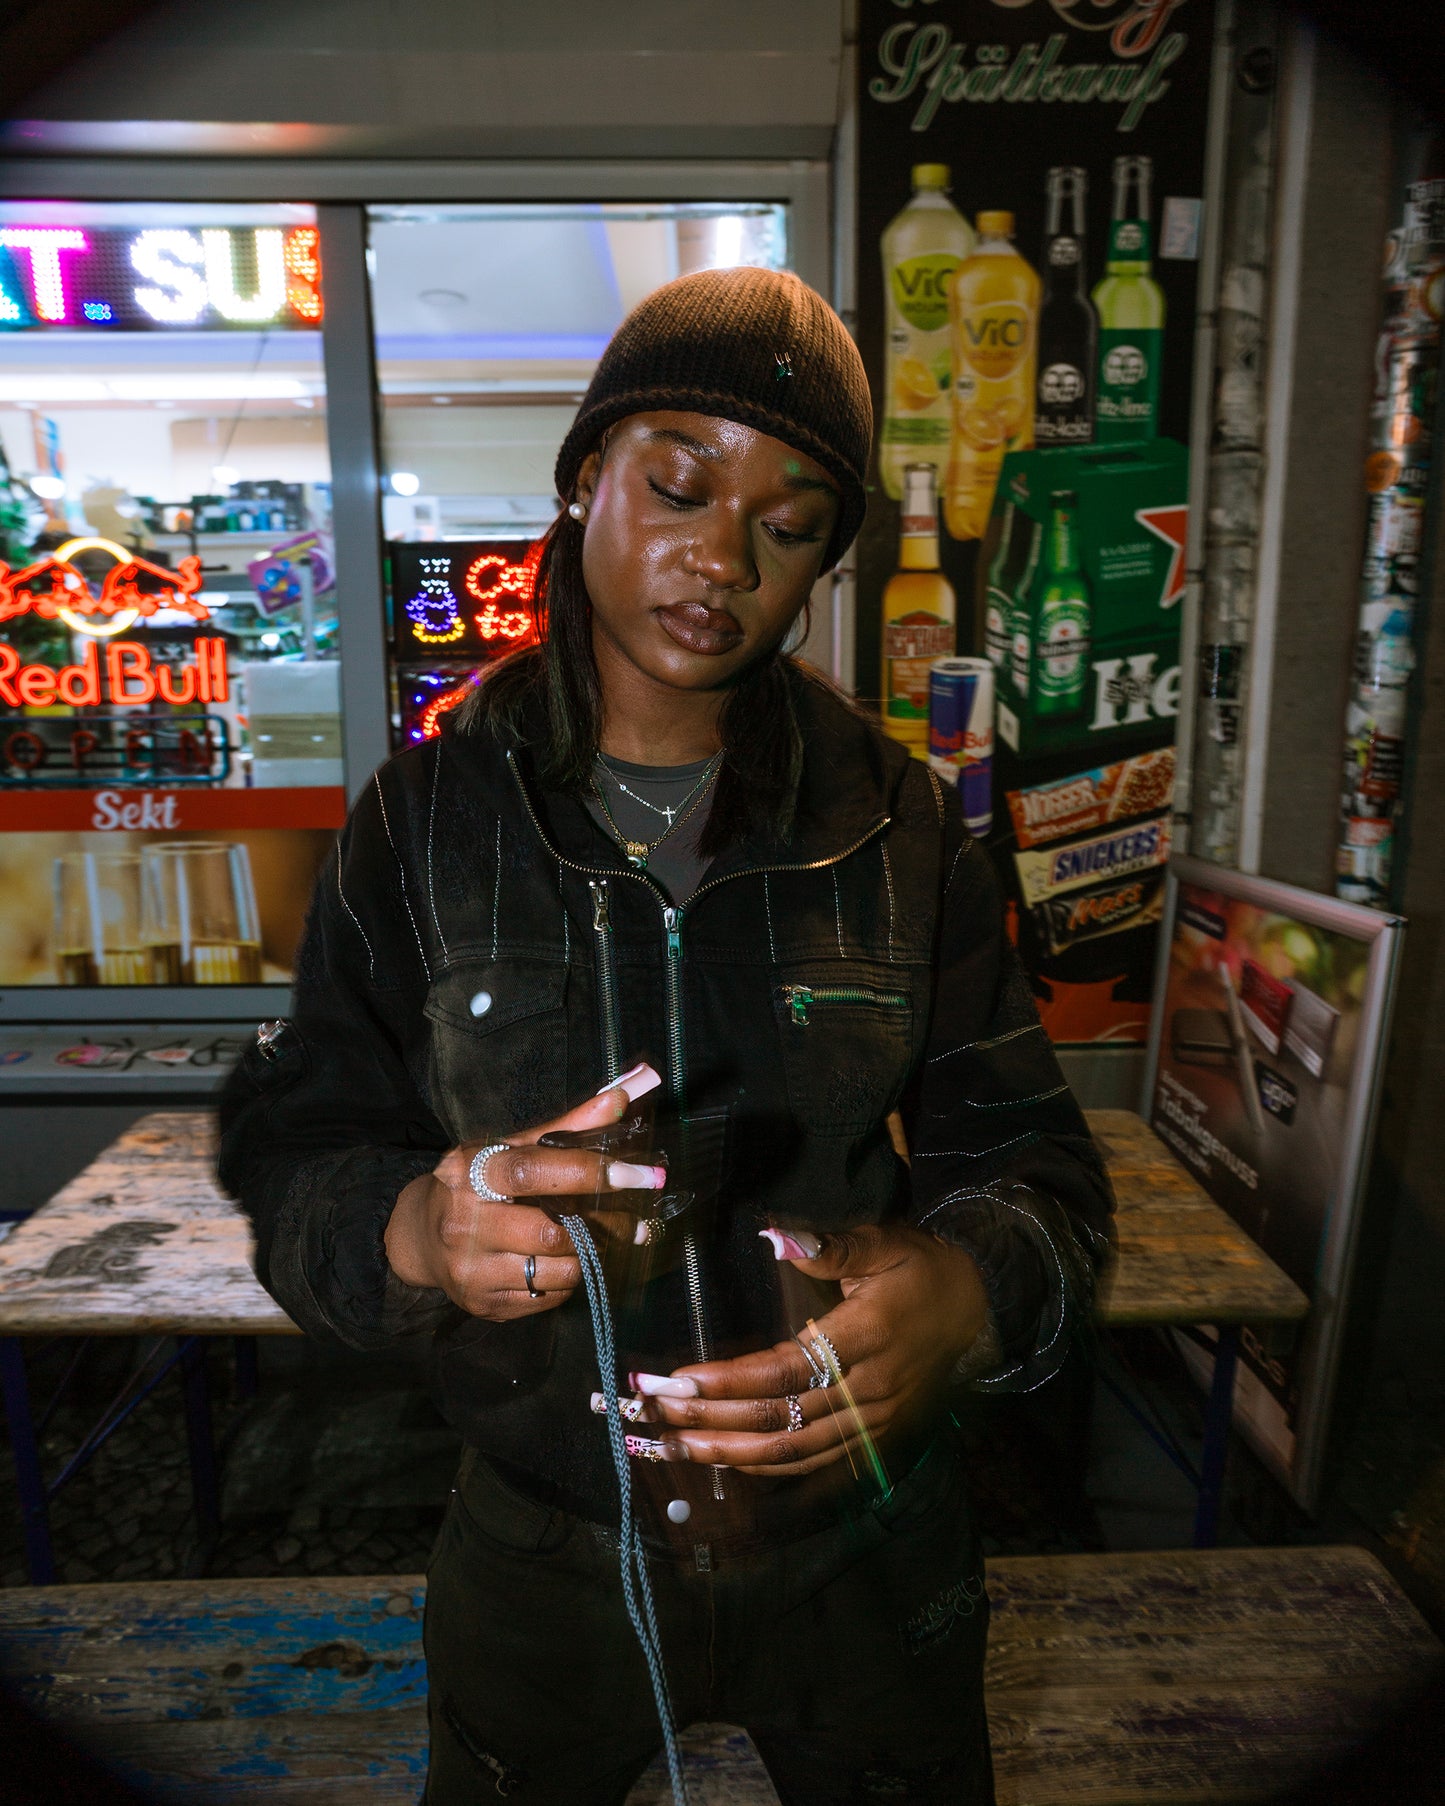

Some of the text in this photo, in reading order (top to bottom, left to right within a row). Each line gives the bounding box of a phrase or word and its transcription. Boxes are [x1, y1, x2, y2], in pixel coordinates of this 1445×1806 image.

[868, 21, 1188, 131] Spätkauf
[106, 636, 230, 705] Bull
[6, 729, 215, 770] OPEN
[92, 791, 182, 830] Sekt
[1055, 826, 1158, 881] SNICKERS
